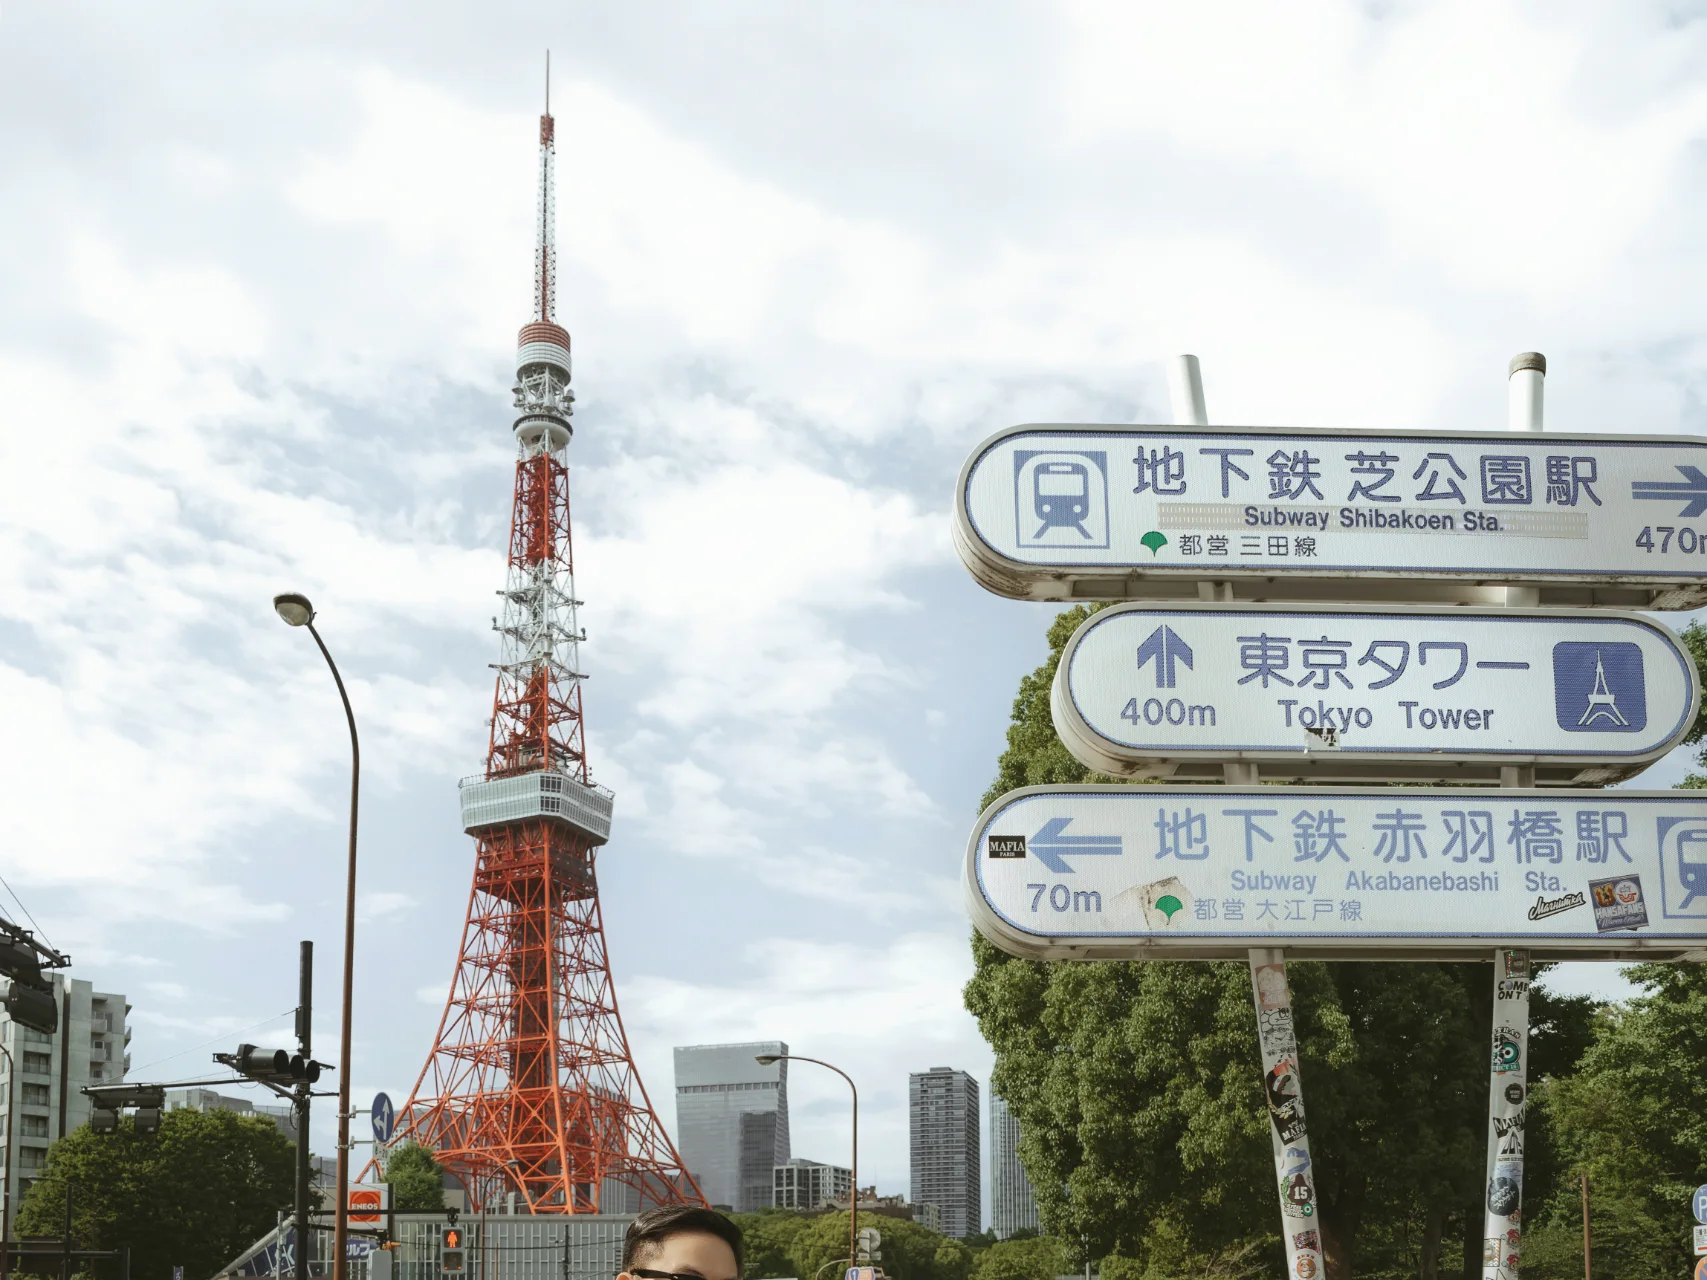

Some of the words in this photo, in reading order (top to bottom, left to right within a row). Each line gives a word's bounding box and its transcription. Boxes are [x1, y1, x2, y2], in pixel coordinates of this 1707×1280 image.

[1133, 445, 1602, 507] 地下鉄芝公園駅
[1244, 506, 1329, 530] Subway
[1340, 507, 1453, 530] Shibakoen
[1463, 510, 1504, 531] Sta.
[1237, 632, 1530, 690] 東京タワー
[1120, 696, 1216, 727] 400m
[1277, 699, 1373, 734] Tokyo
[1398, 700, 1494, 731] Tower
[989, 841, 1025, 852] MAFIA
[1153, 807, 1632, 864] 地下鉄赤羽橋駅
[1231, 869, 1317, 896] Subway
[1345, 870, 1499, 893] Akabanebashi
[1525, 870, 1568, 892] Sta.
[1026, 883, 1102, 914] 70m
[1594, 901, 1645, 920] HANSAFANS
[351, 1202, 379, 1210] ENEOS
[1294, 1186, 1308, 1200] 15
[346, 1243, 370, 1256] ルフ
